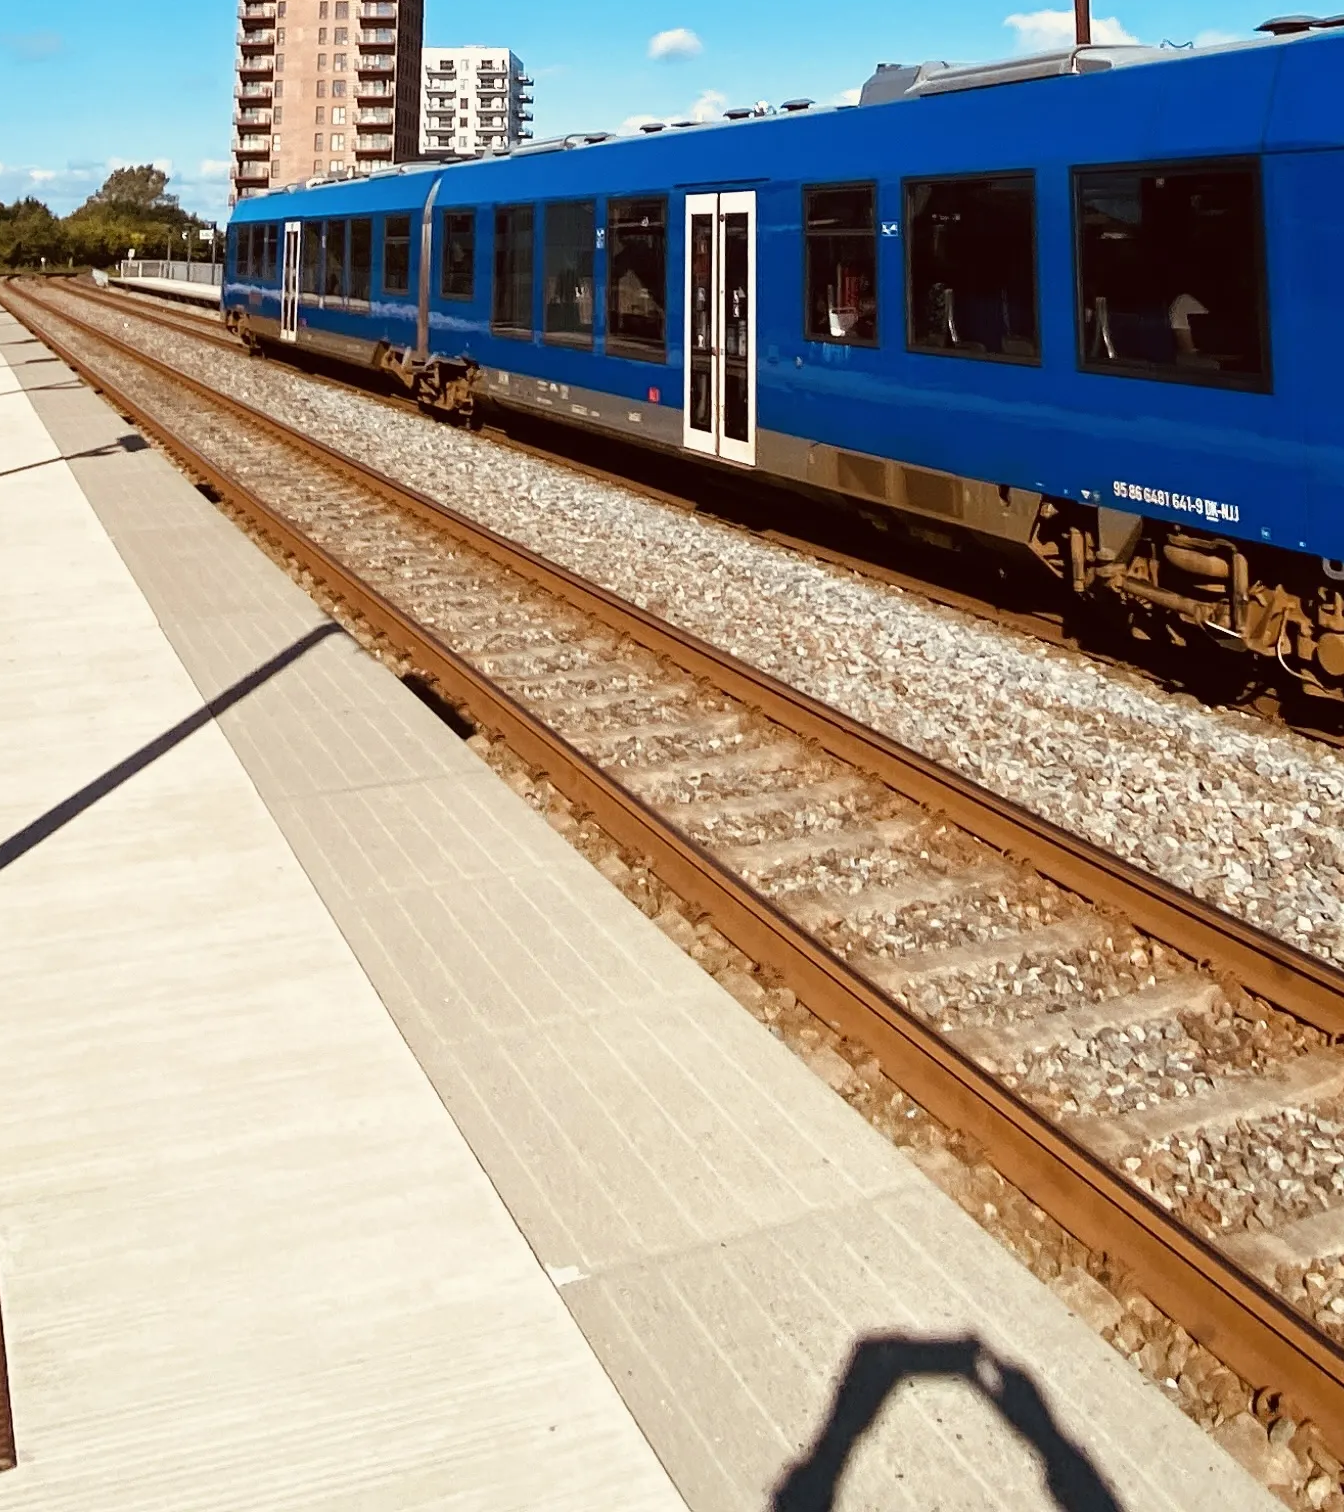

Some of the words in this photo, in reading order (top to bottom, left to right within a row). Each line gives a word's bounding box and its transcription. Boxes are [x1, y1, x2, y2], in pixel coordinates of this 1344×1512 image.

[1113, 480, 1127, 498] 95
[1128, 484, 1142, 501] 86
[1143, 487, 1169, 506] 6481
[1171, 493, 1203, 514] 641-9
